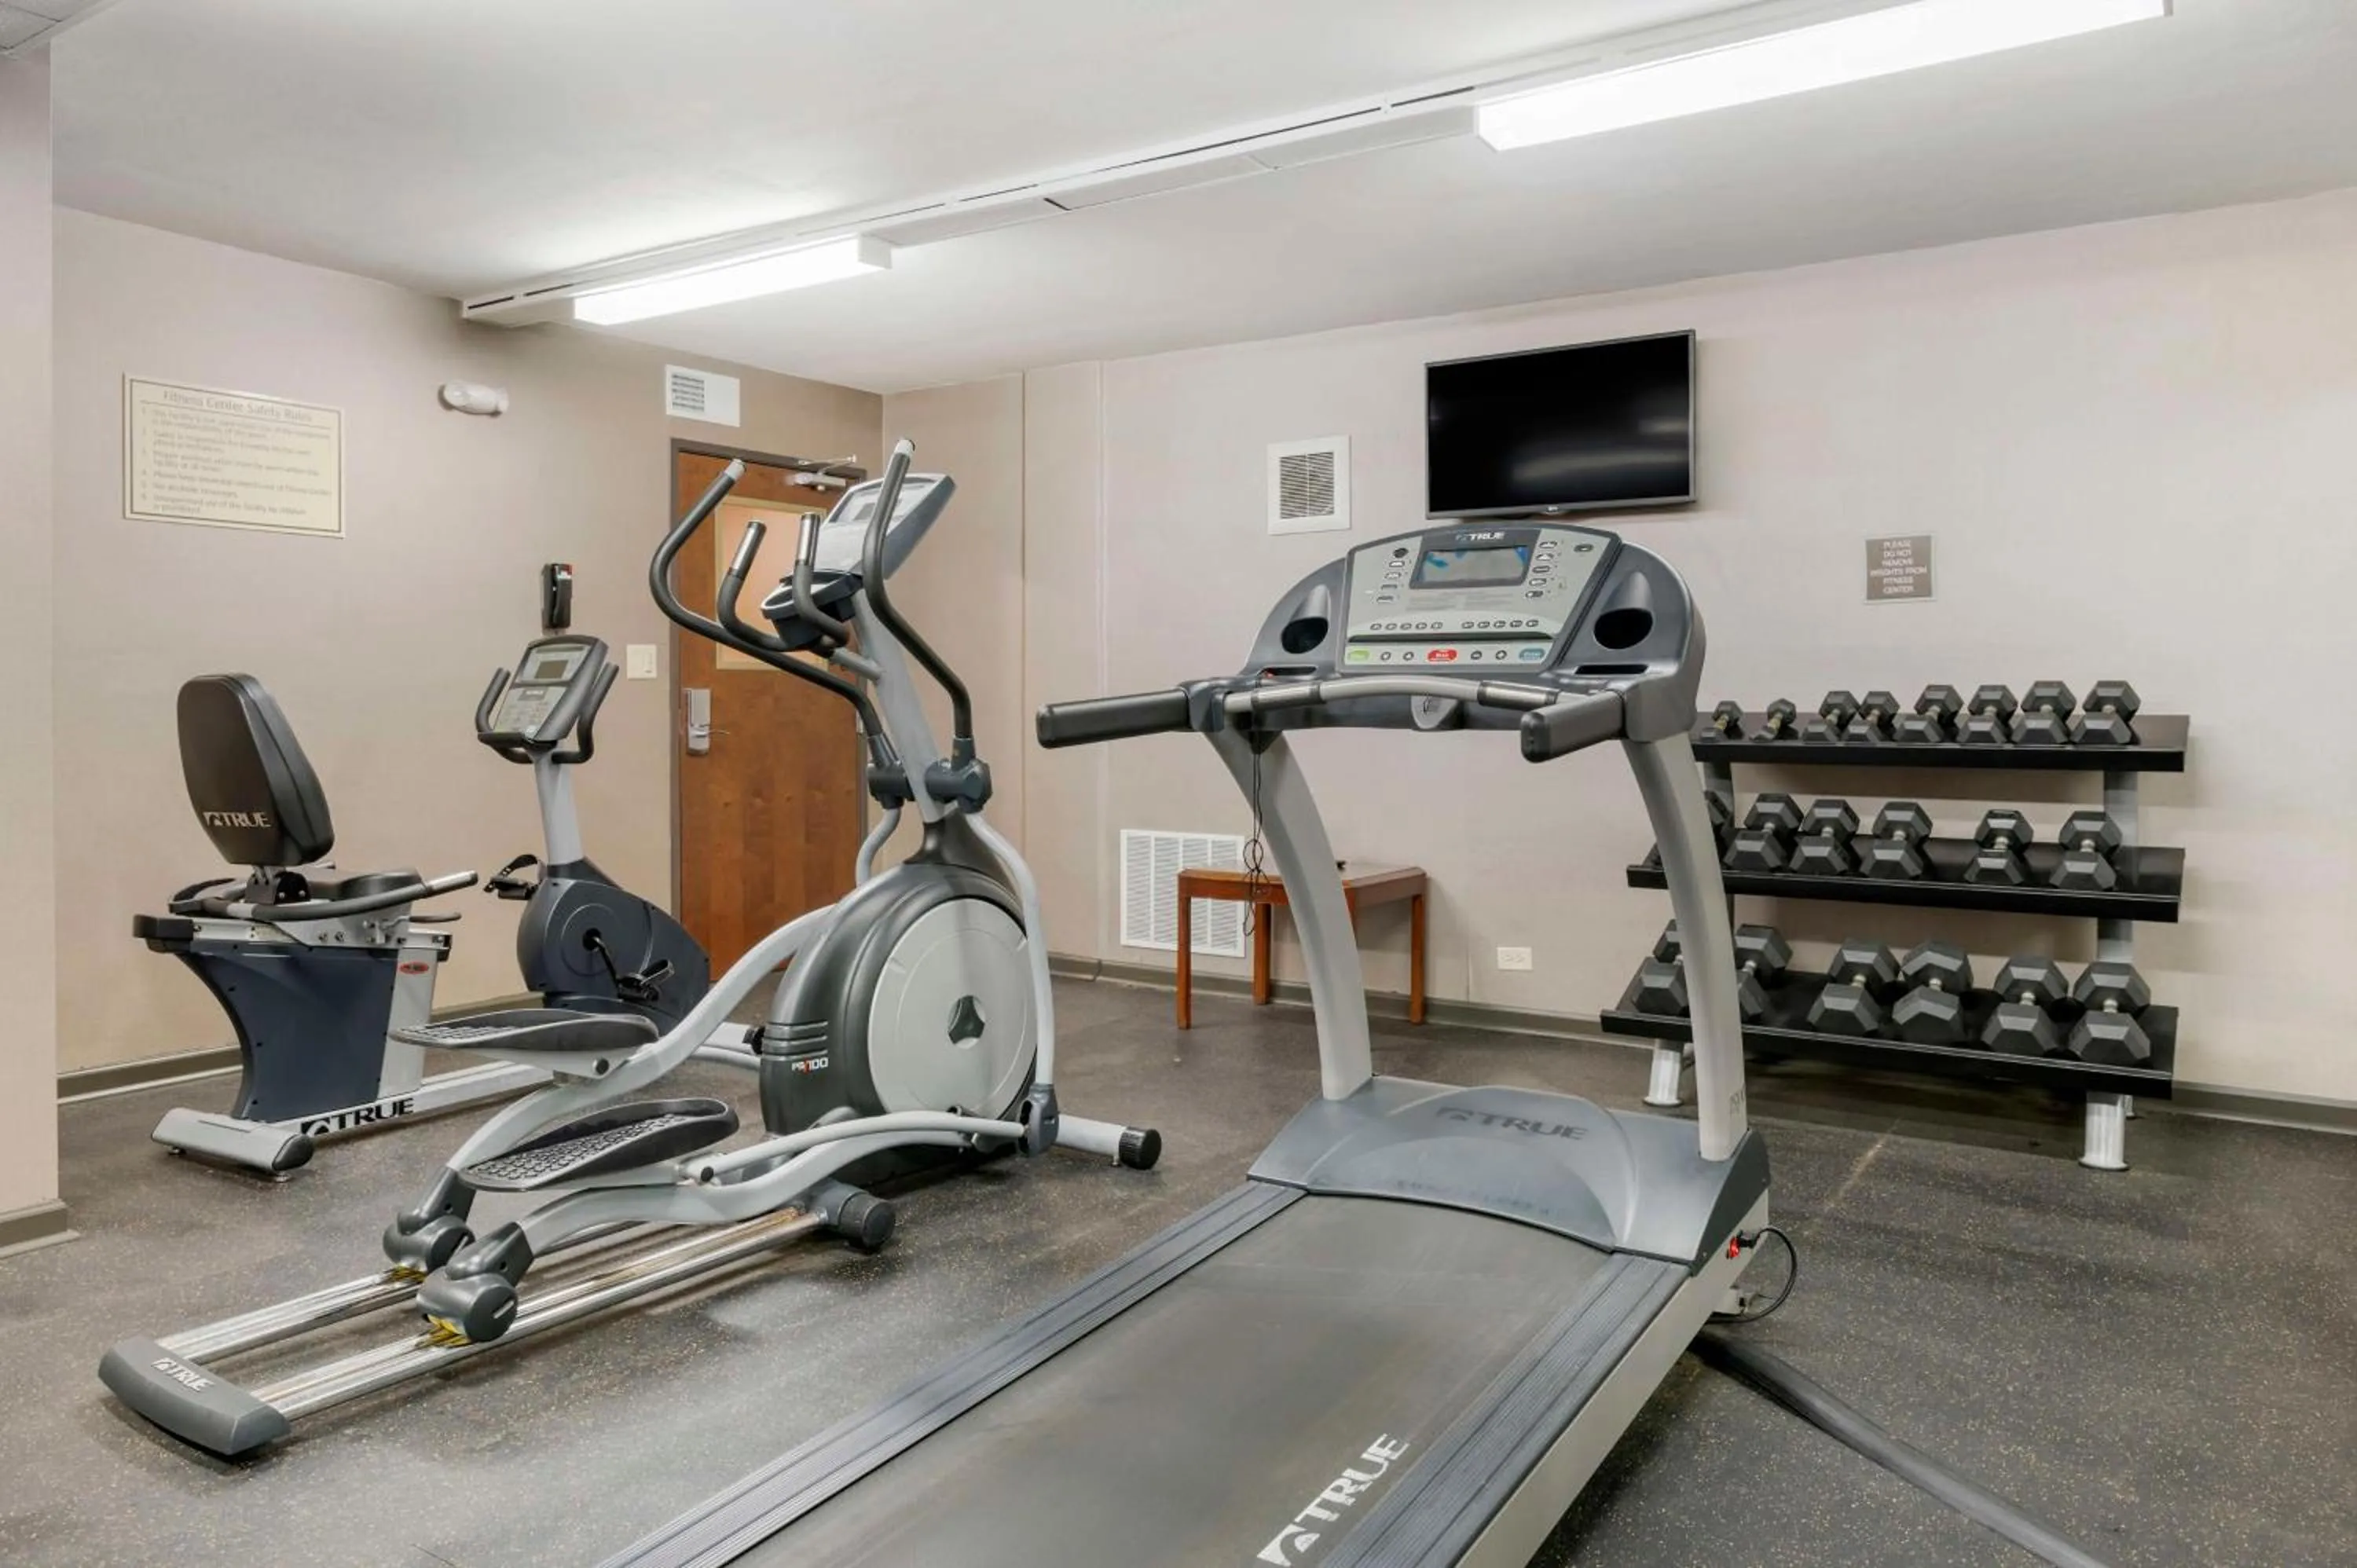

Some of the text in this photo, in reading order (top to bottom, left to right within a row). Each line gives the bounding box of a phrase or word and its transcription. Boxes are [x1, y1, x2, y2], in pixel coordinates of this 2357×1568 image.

[1465, 531, 1506, 541] TRUE
[1883, 540, 1911, 549] PLEASE
[221, 811, 271, 827] TRUE
[331, 1097, 414, 1130] TRUE
[1474, 1112, 1588, 1141] TRUE
[164, 1363, 216, 1393] TRUE
[1294, 1432, 1410, 1523] TRUE
